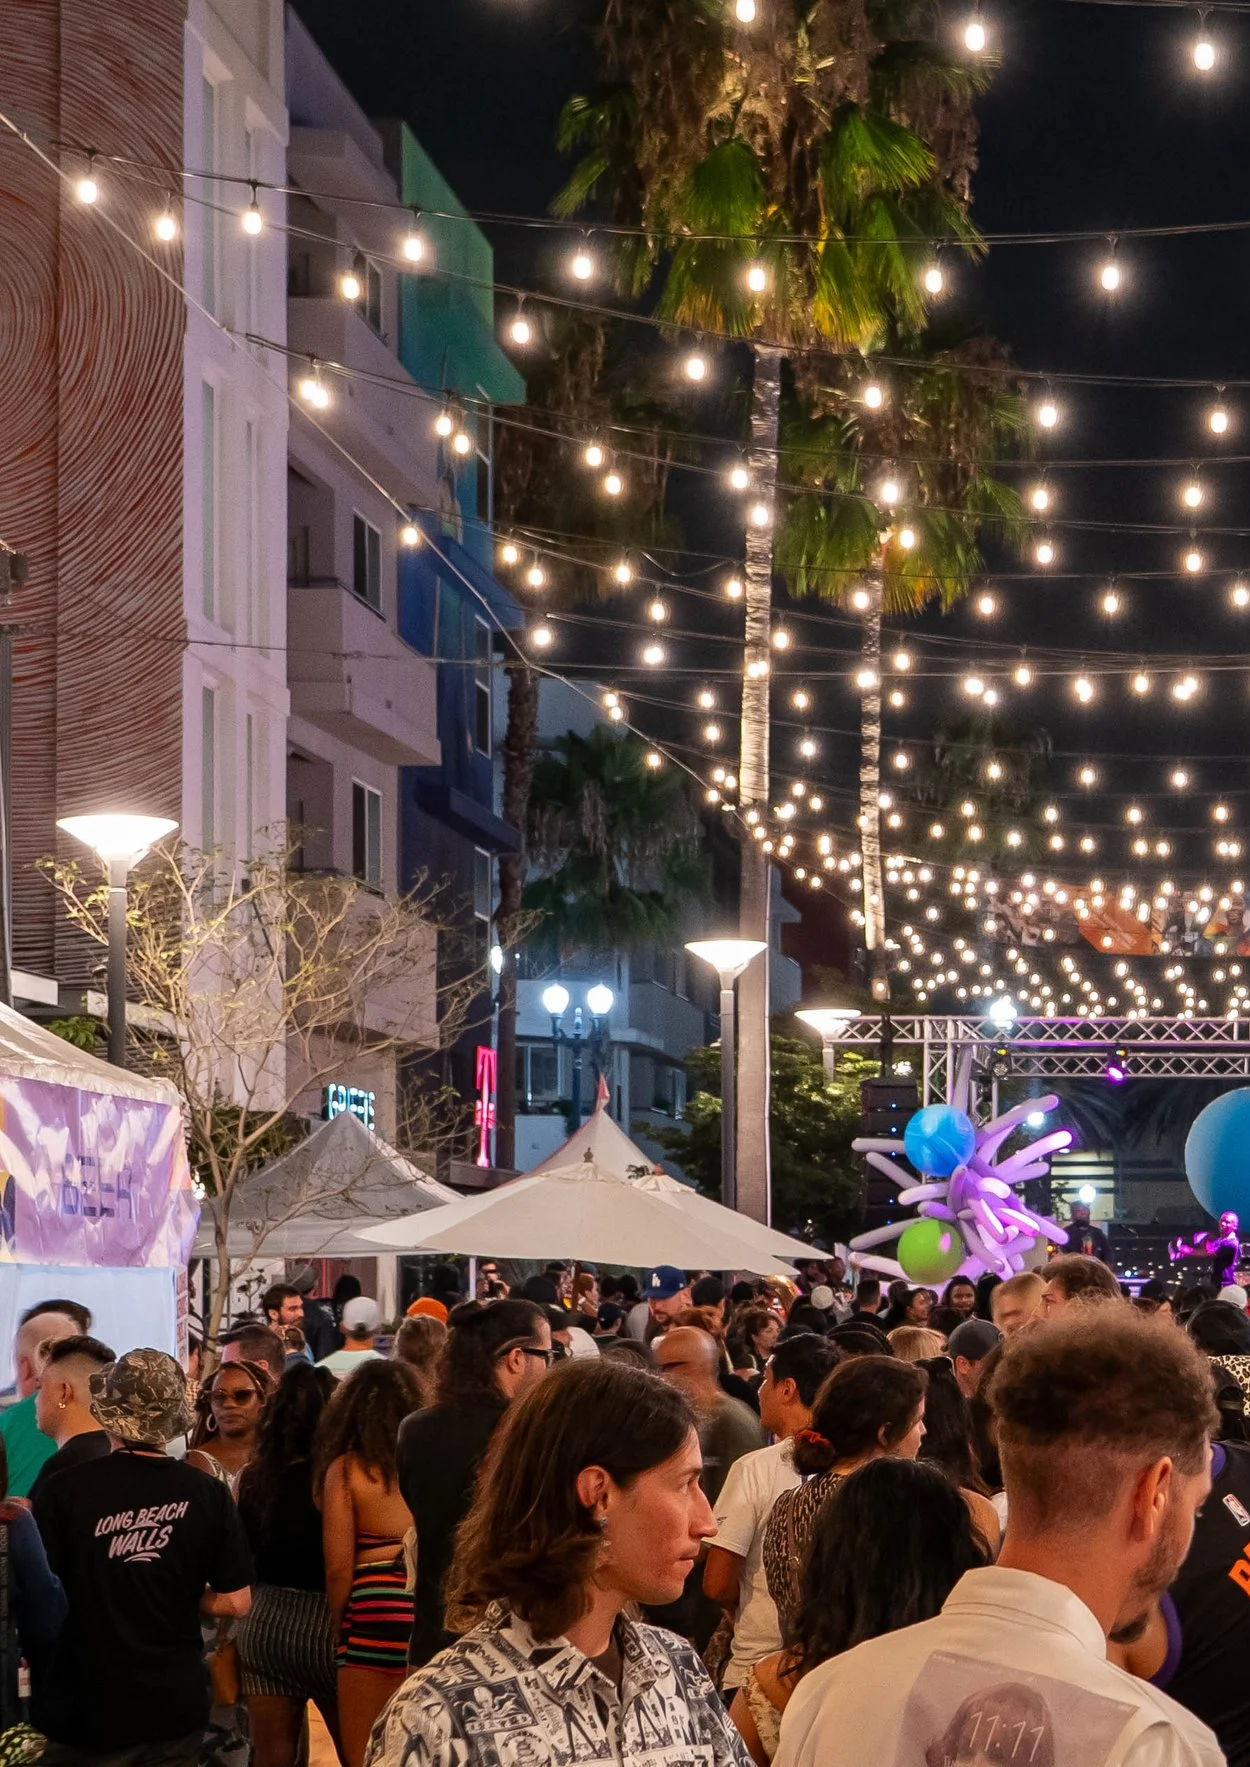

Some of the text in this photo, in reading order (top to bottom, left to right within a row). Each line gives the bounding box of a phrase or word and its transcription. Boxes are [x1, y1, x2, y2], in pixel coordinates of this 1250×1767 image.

[94, 1501, 190, 1537] LONG BEACH
[108, 1525, 173, 1559] WALLS
[969, 1711, 1045, 1763] 11:11
